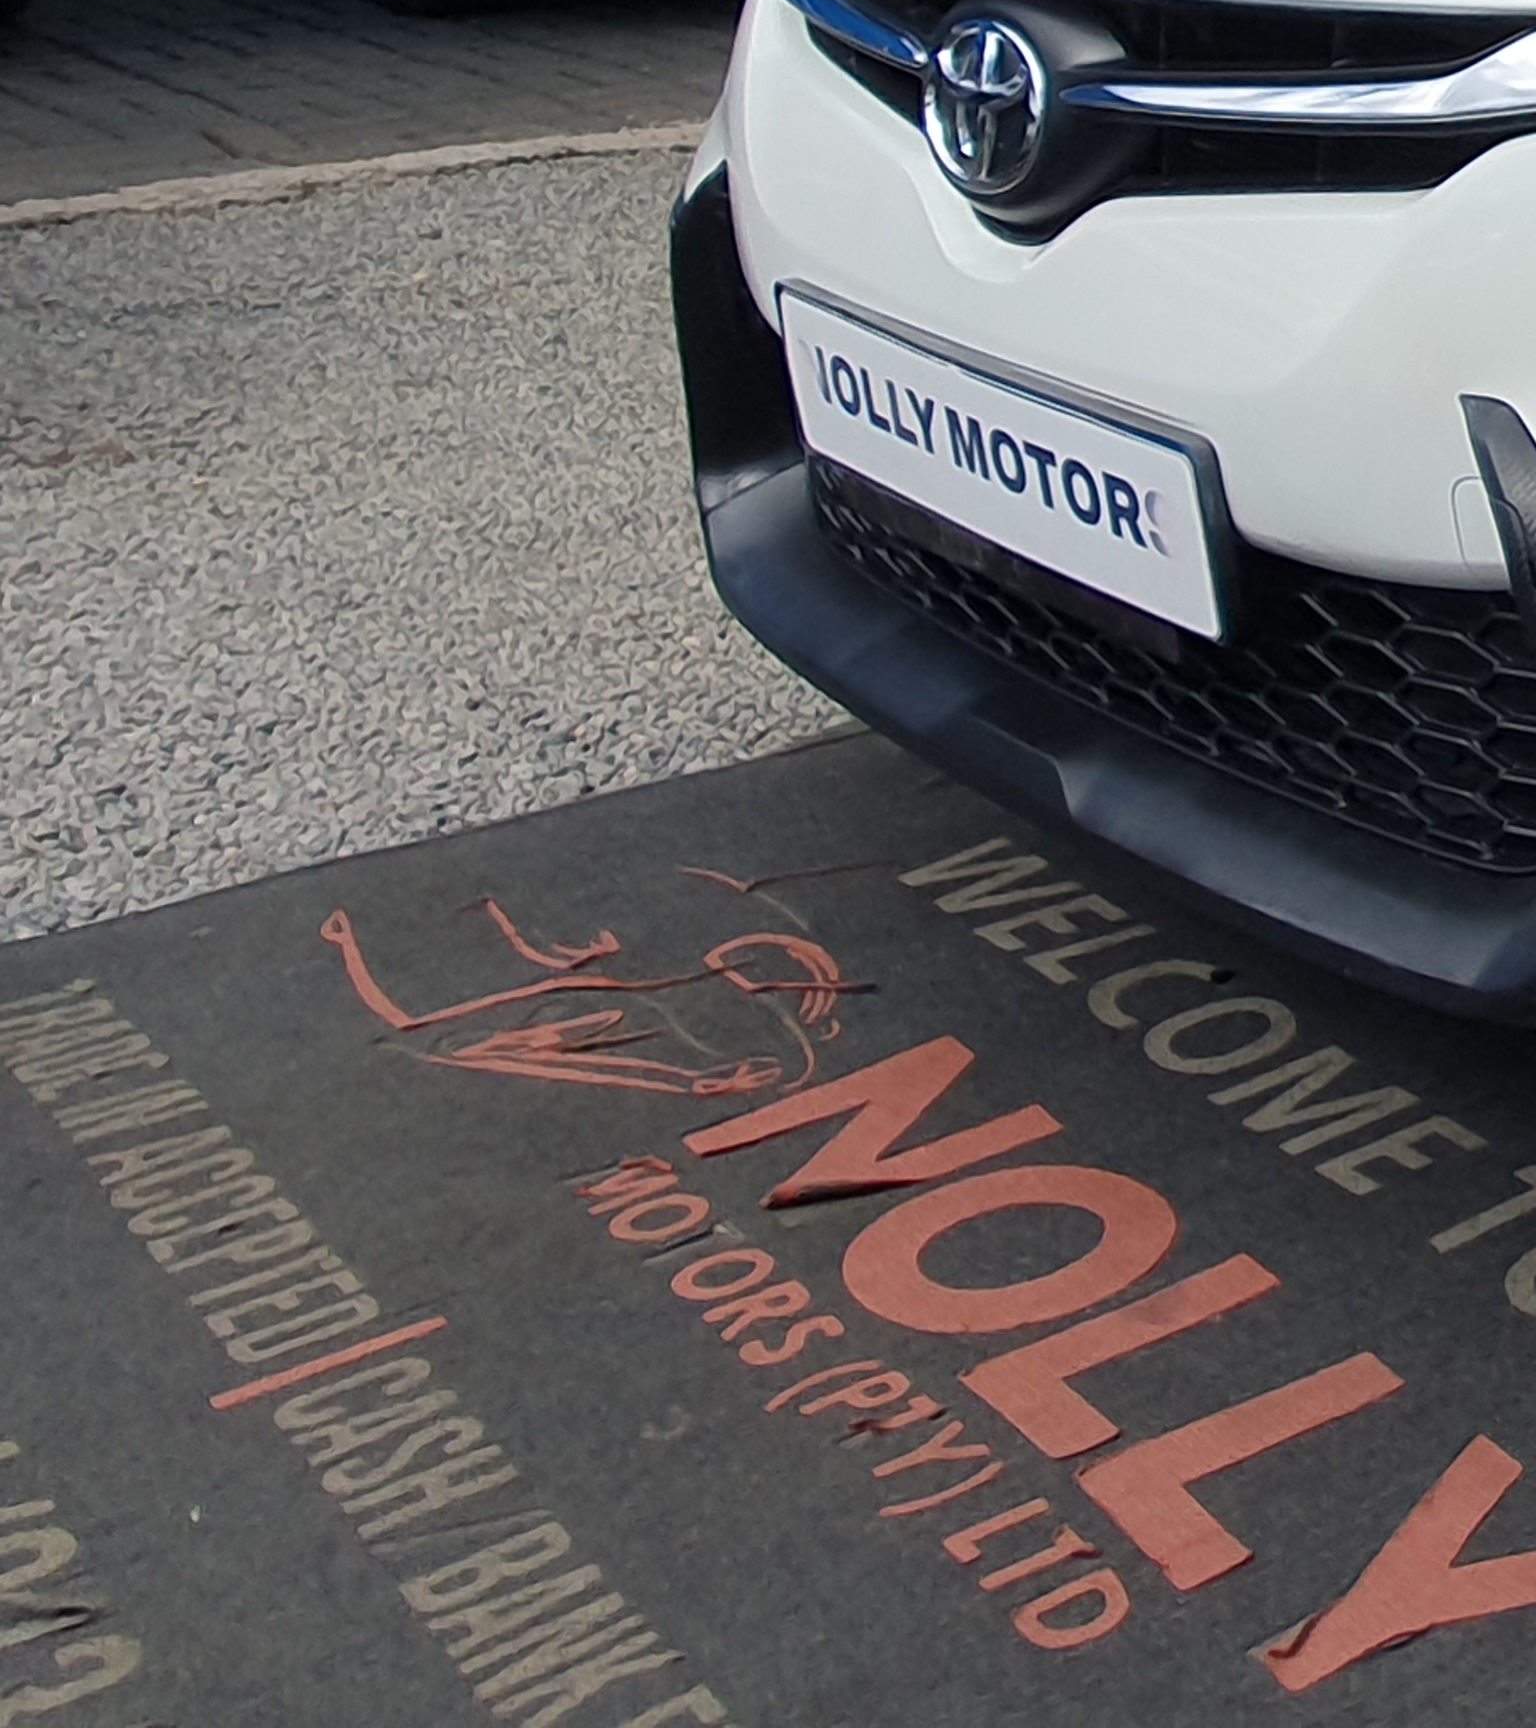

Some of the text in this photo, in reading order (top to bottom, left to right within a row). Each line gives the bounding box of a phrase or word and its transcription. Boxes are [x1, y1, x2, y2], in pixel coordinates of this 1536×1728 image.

[897, 837, 1487, 1196] WELCOME
[763, 1359, 1004, 1518] (PTY)
[942, 1498, 1132, 1650] LTD
